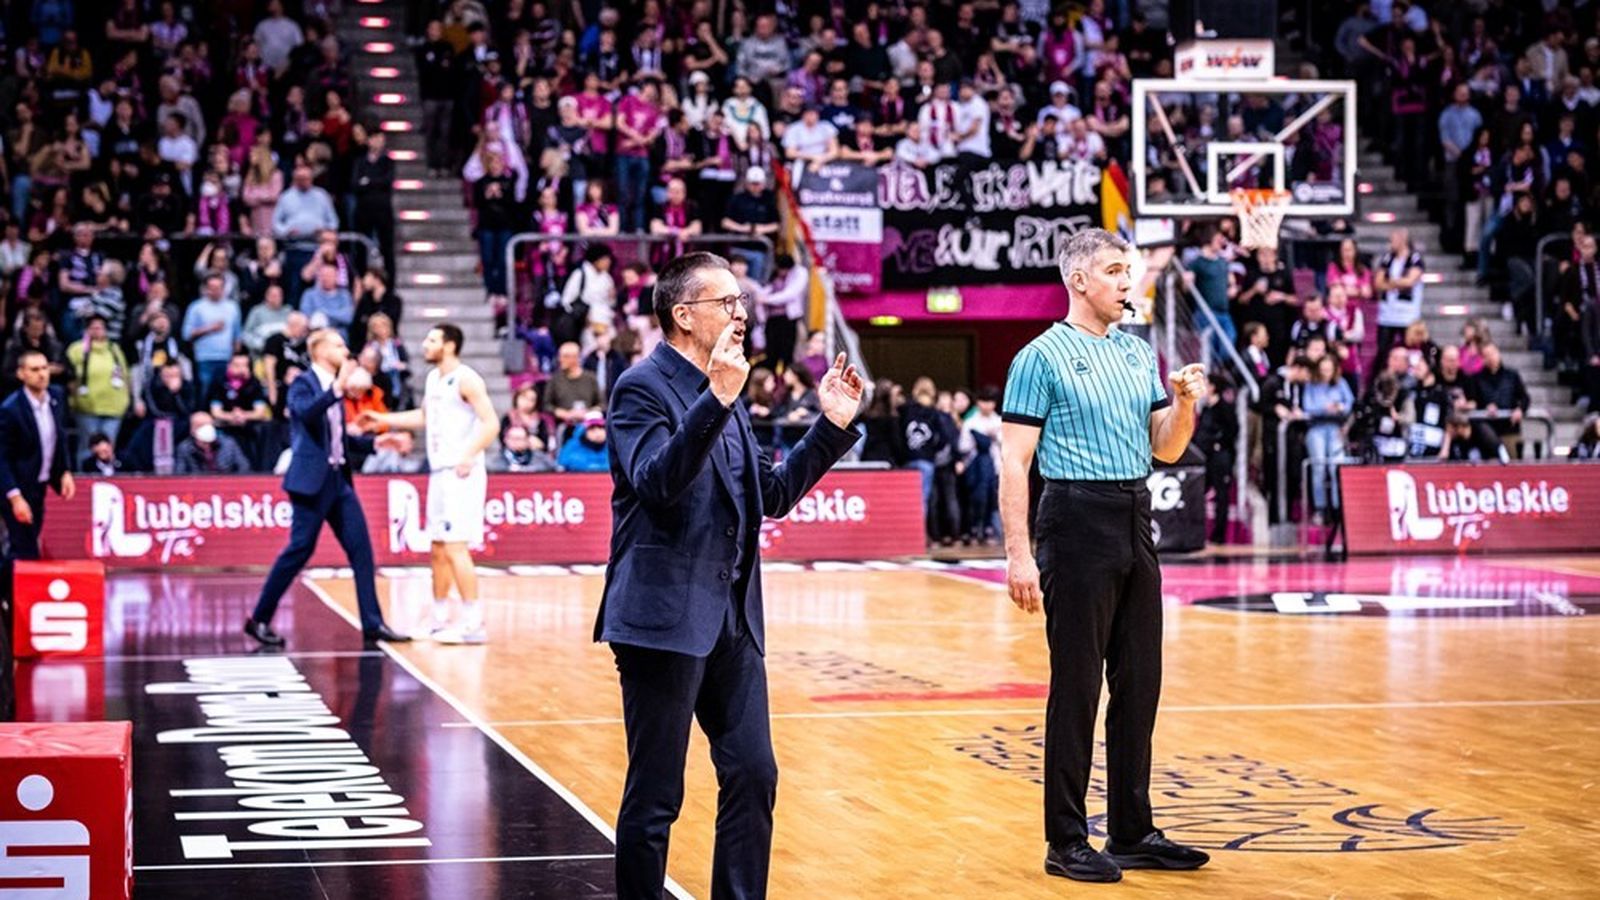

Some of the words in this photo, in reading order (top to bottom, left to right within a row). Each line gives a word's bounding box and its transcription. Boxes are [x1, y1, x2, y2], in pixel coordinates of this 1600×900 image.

[812, 216, 860, 232] statt
[134, 495, 294, 529] lubelskie
[485, 491, 585, 524] elskie
[1425, 481, 1569, 513] lubelskie
[169, 741, 432, 859] Telekom
